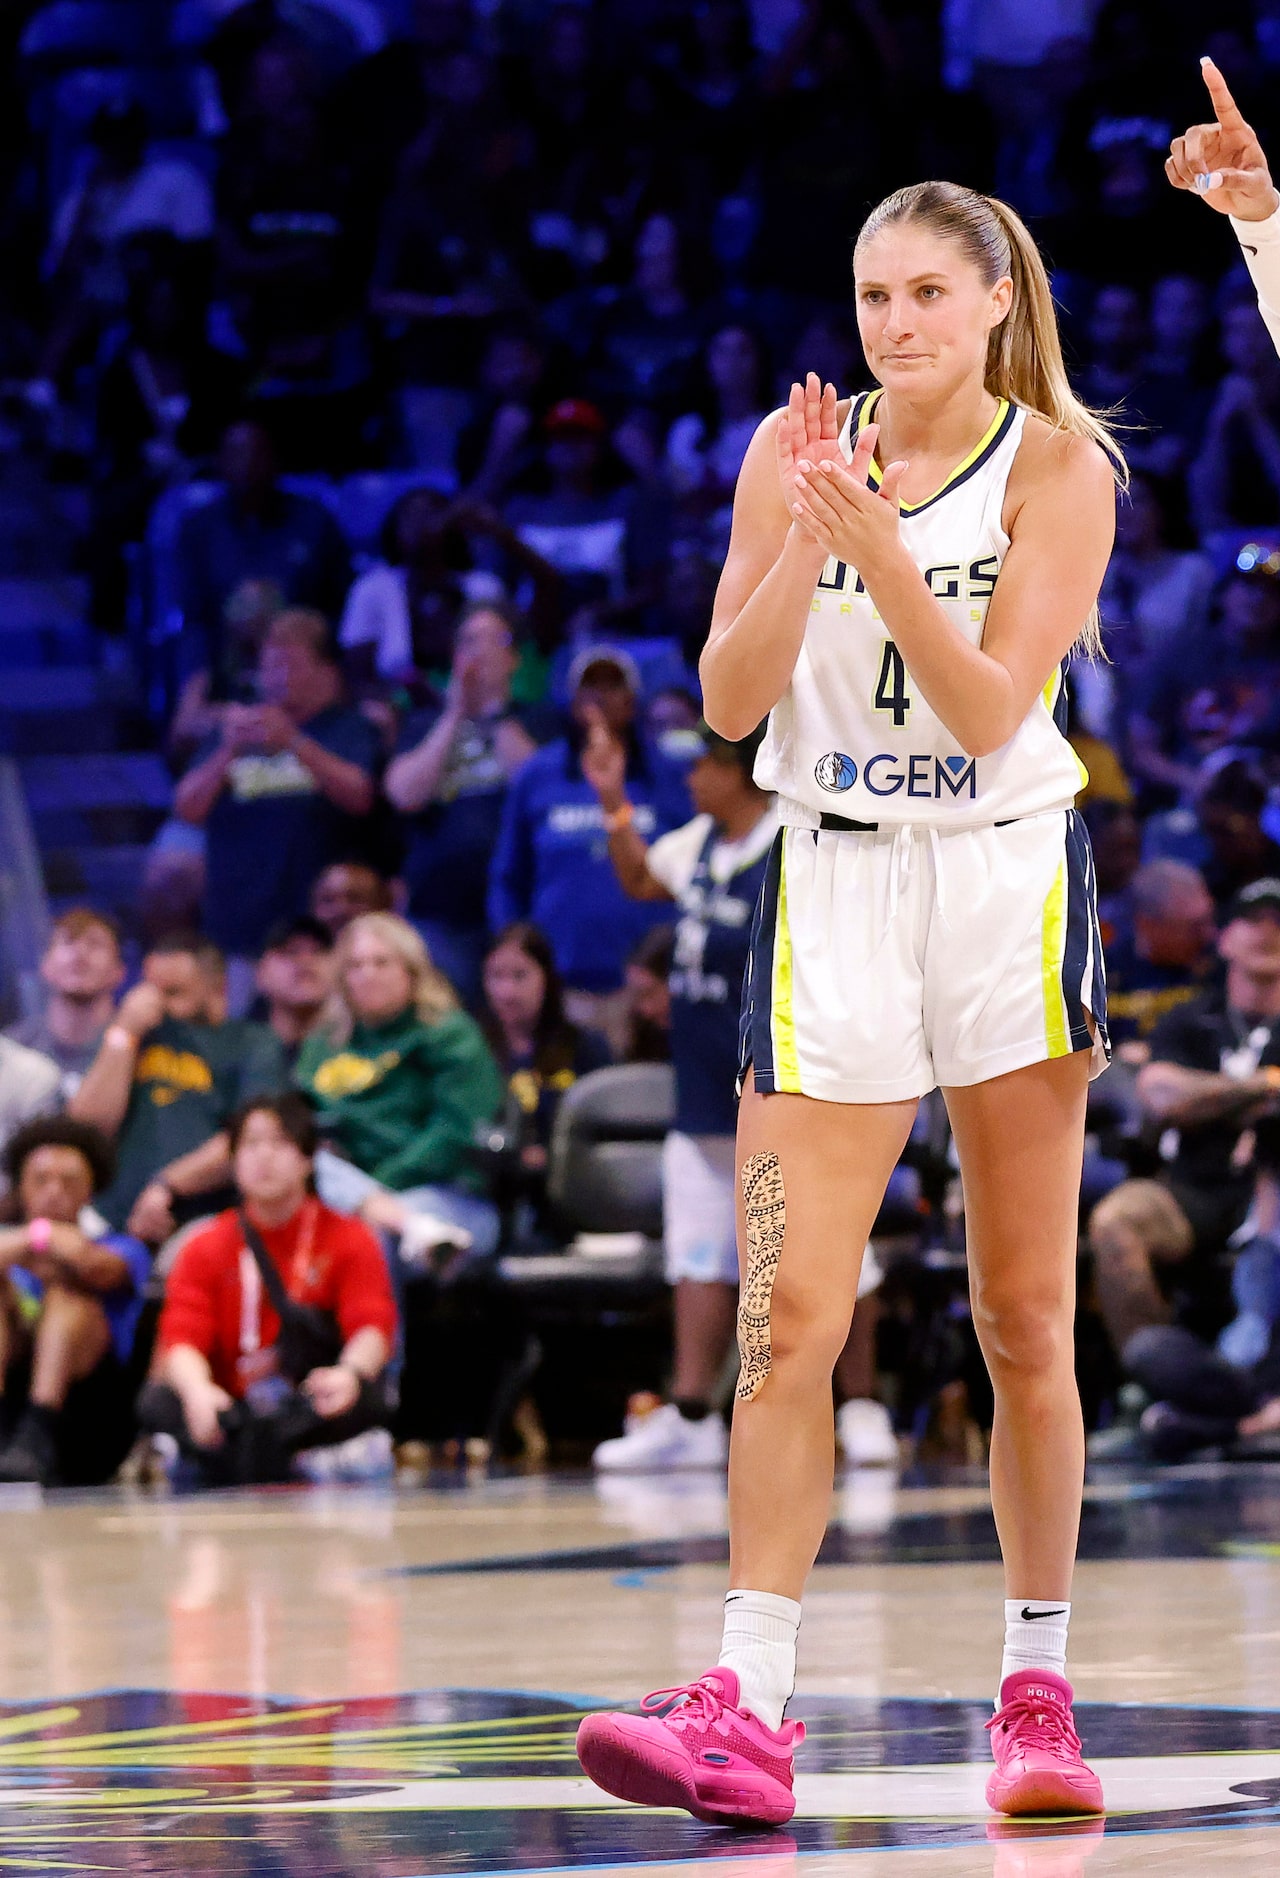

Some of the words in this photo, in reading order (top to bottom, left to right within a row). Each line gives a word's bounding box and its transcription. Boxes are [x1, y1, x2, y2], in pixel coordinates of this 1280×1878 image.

[811, 599, 981, 621] DALS
[873, 639, 912, 727] 4
[863, 753, 977, 799] GEM
